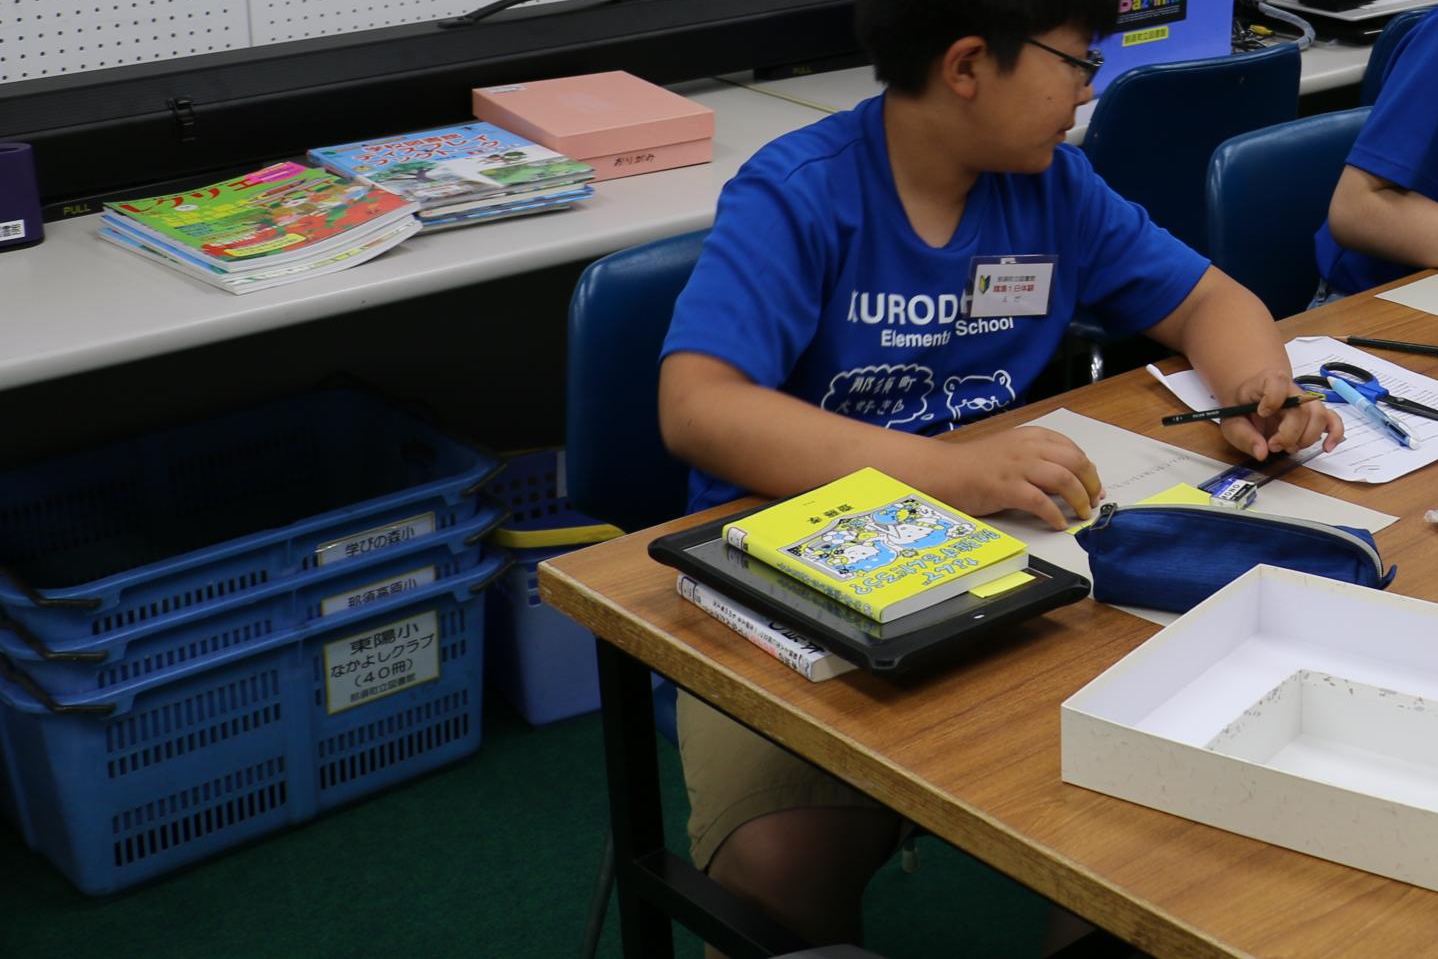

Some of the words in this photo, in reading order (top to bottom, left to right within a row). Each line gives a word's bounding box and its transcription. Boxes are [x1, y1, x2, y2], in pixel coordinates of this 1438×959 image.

[955, 317, 1014, 337] School
[345, 526, 415, 557] 学びの森小
[348, 578, 418, 608] 那須高原小
[350, 623, 419, 655] 東陽小
[331, 634, 435, 679] なかよしクラブ
